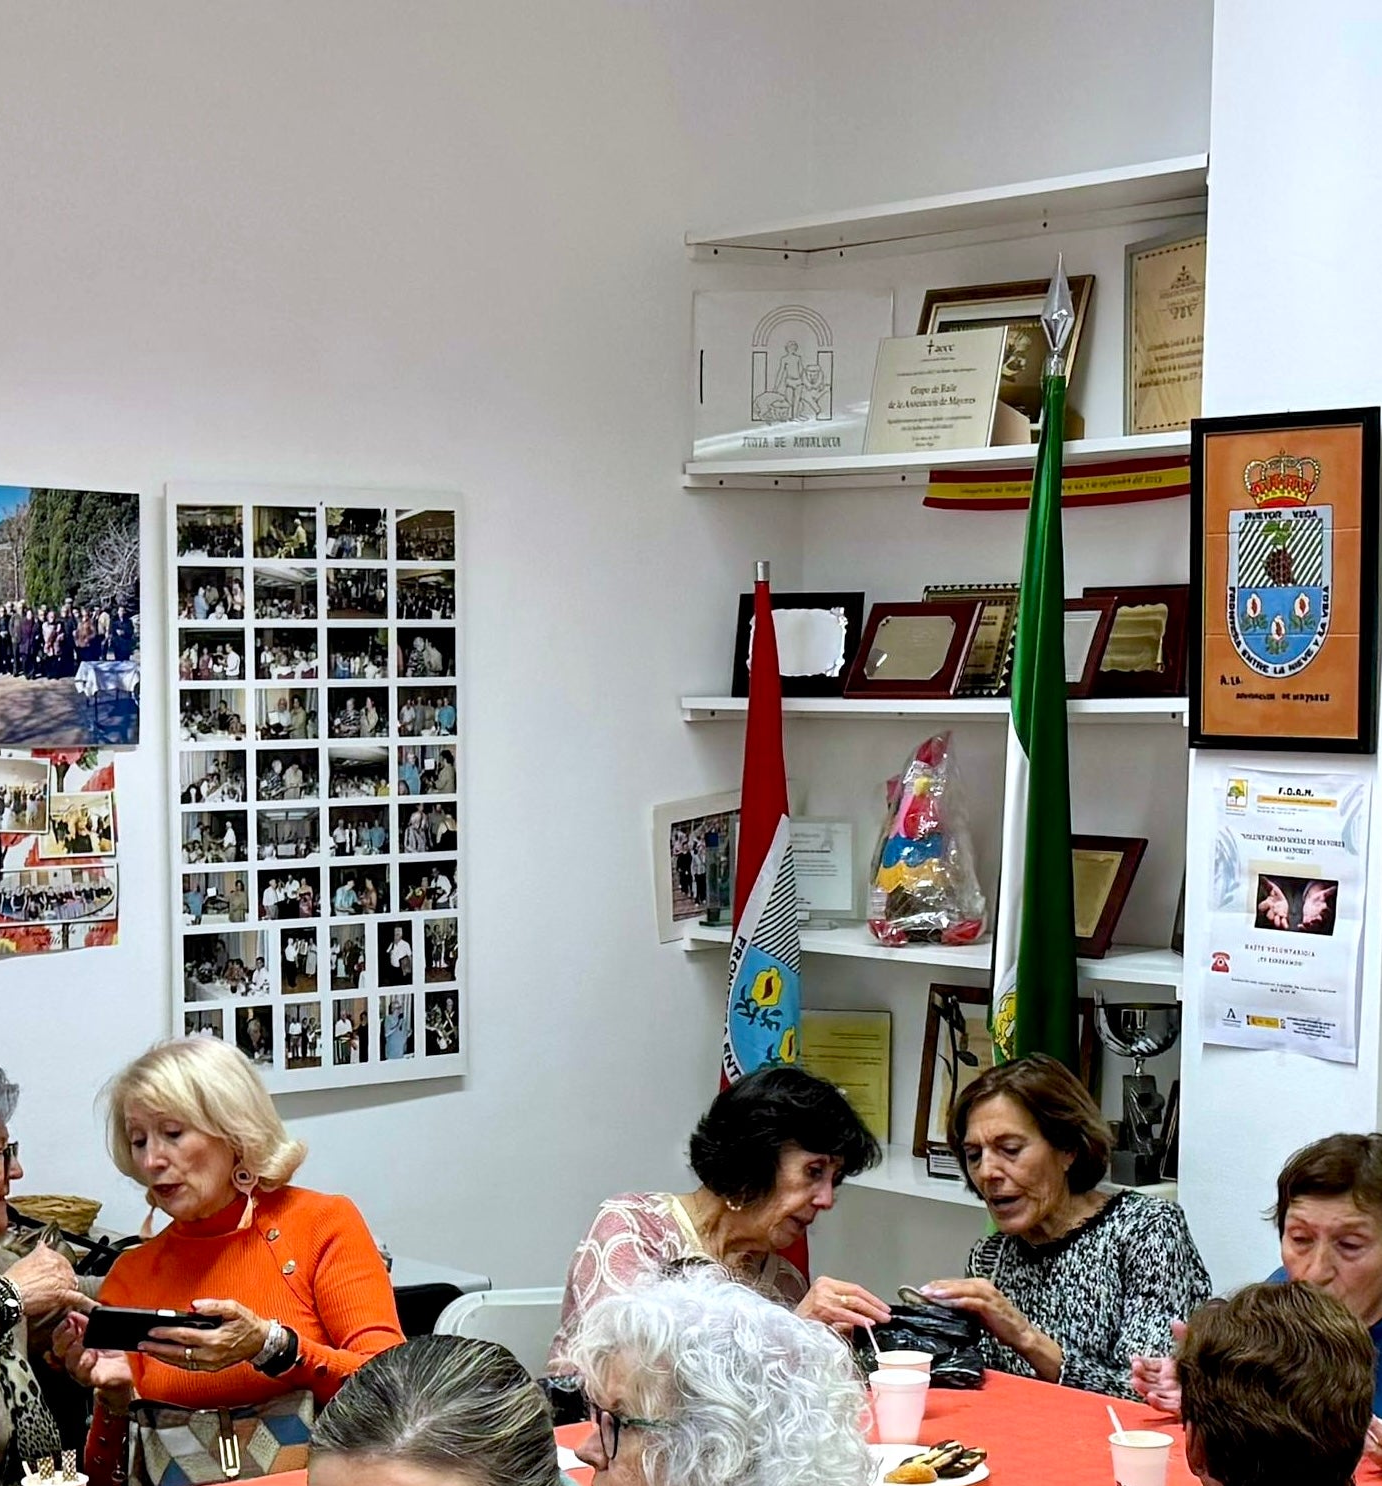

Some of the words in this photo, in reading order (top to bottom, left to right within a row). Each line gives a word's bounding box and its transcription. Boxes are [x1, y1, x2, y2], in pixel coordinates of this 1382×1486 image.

[774, 437, 786, 448] DE
[1292, 510, 1318, 519] VEGA
[1241, 649, 1269, 673] ENTRE
[1273, 666, 1285, 675] LA
[1288, 649, 1314, 672] NIEVE
[1313, 639, 1320, 647] Y
[1317, 622, 1327, 638] LA
